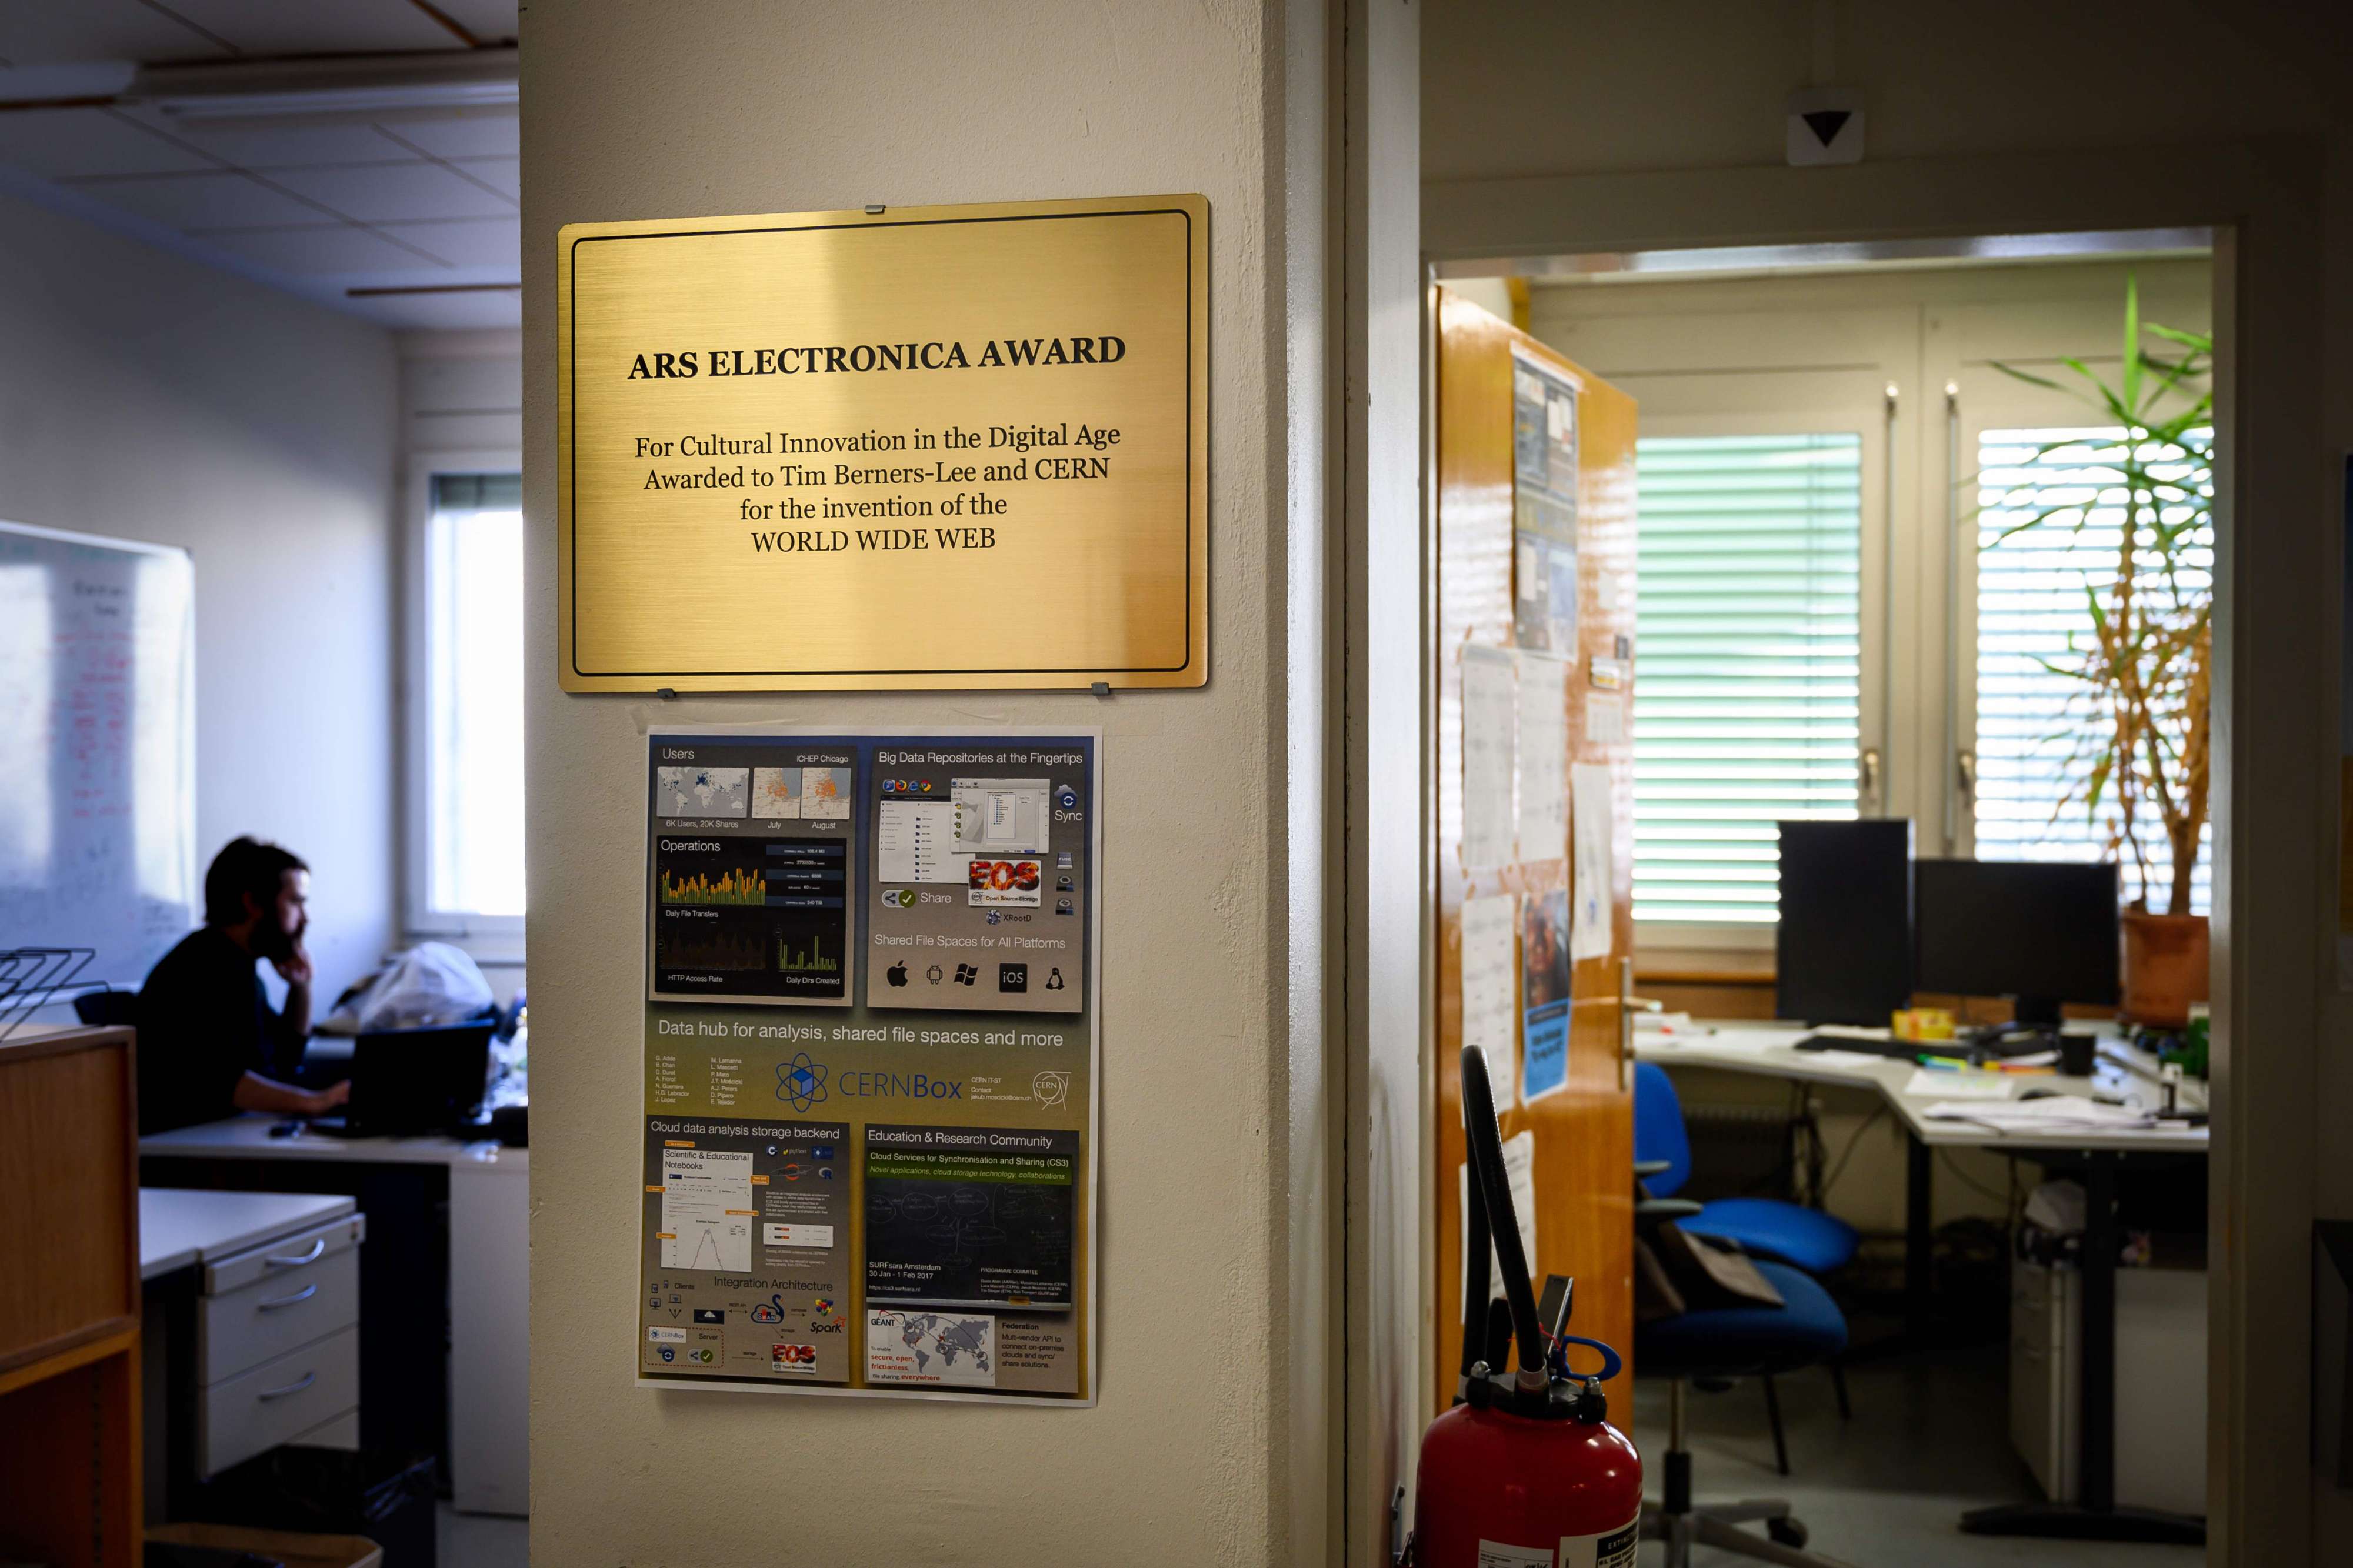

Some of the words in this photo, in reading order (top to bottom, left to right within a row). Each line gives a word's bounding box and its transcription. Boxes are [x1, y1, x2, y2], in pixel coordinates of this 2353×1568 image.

[628, 352, 698, 379] ARS
[708, 342, 971, 376] ELECTRONICA
[978, 336, 1125, 367] AWARD
[635, 438, 674, 457] For
[681, 432, 772, 456] Cultural
[780, 430, 906, 453] Innovation
[914, 428, 936, 449] in
[944, 426, 981, 448] the
[989, 423, 1068, 452] Digital
[1075, 424, 1120, 450] Age
[644, 466, 745, 489] Awarded
[751, 469, 773, 486] to
[780, 465, 826, 486] Tim
[835, 462, 976, 484] Berners-Lee
[984, 458, 1028, 481] and
[1035, 458, 1110, 479] CERN
[741, 499, 773, 519] for
[779, 498, 815, 519] the
[823, 495, 933, 518] invention
[941, 493, 965, 515] of
[969, 493, 1007, 515] the
[751, 531, 848, 552] WORLD
[855, 529, 928, 550] WIDE
[935, 528, 995, 549] WEB
[663, 748, 694, 759] Users
[821, 755, 848, 763] Chicago
[879, 752, 896, 765] Big
[900, 752, 924, 762] Data
[928, 753, 993, 765] Repositories
[997, 753, 1006, 763] at
[1010, 753, 1027, 763] the
[1031, 753, 1082, 765] Fingertips
[1055, 810, 1082, 823] Sync
[812, 822, 836, 830] August
[661, 840, 720, 853] Operations
[969, 862, 1040, 891] EOS
[921, 892, 951, 903] Share
[875, 934, 912, 945] Shared
[916, 935, 934, 945] File
[937, 936, 977, 948] Spaces
[981, 936, 995, 946] for
[998, 937, 1010, 947] All
[1015, 937, 1065, 948] Platforms
[1004, 972, 1023, 983] iOS
[659, 1020, 694, 1035] Data
[699, 1021, 728, 1036] hub
[733, 1022, 754, 1037] for
[759, 1024, 826, 1042] analysis,
[833, 1026, 886, 1041] shared
[892, 1027, 915, 1042] file
[921, 1032, 979, 1046] spaces
[985, 1030, 1015, 1045] and
[1022, 1035, 1063, 1046] more
[839, 1072, 963, 1099] CERNBox
[651, 1121, 680, 1132] Cloud
[684, 1123, 705, 1133] data
[709, 1125, 749, 1137] analysis
[752, 1126, 791, 1139] storage
[795, 1127, 839, 1139] backend
[869, 1130, 921, 1142] Education
[925, 1132, 932, 1142] &
[936, 1133, 986, 1144] Research
[990, 1135, 1052, 1149] Community
[665, 1150, 698, 1159] Scientific
[698, 1150, 705, 1159] &
[707, 1151, 750, 1160] Educational
[939, 1155, 997, 1163] Synchronisation
[1016, 1157, 1044, 1167] Sharing
[1047, 1159, 1068, 1167] (CS3)
[665, 1161, 702, 1169] Notebooks
[715, 1276, 768, 1289] Integration
[771, 1279, 833, 1291] Architecture
[758, 1313, 776, 1321] SWAN
[871, 1317, 896, 1326] GÉANT
[810, 1322, 842, 1334] Spark
[773, 1345, 815, 1363] EOS
[1029, 1345, 1064, 1353] on-premise
